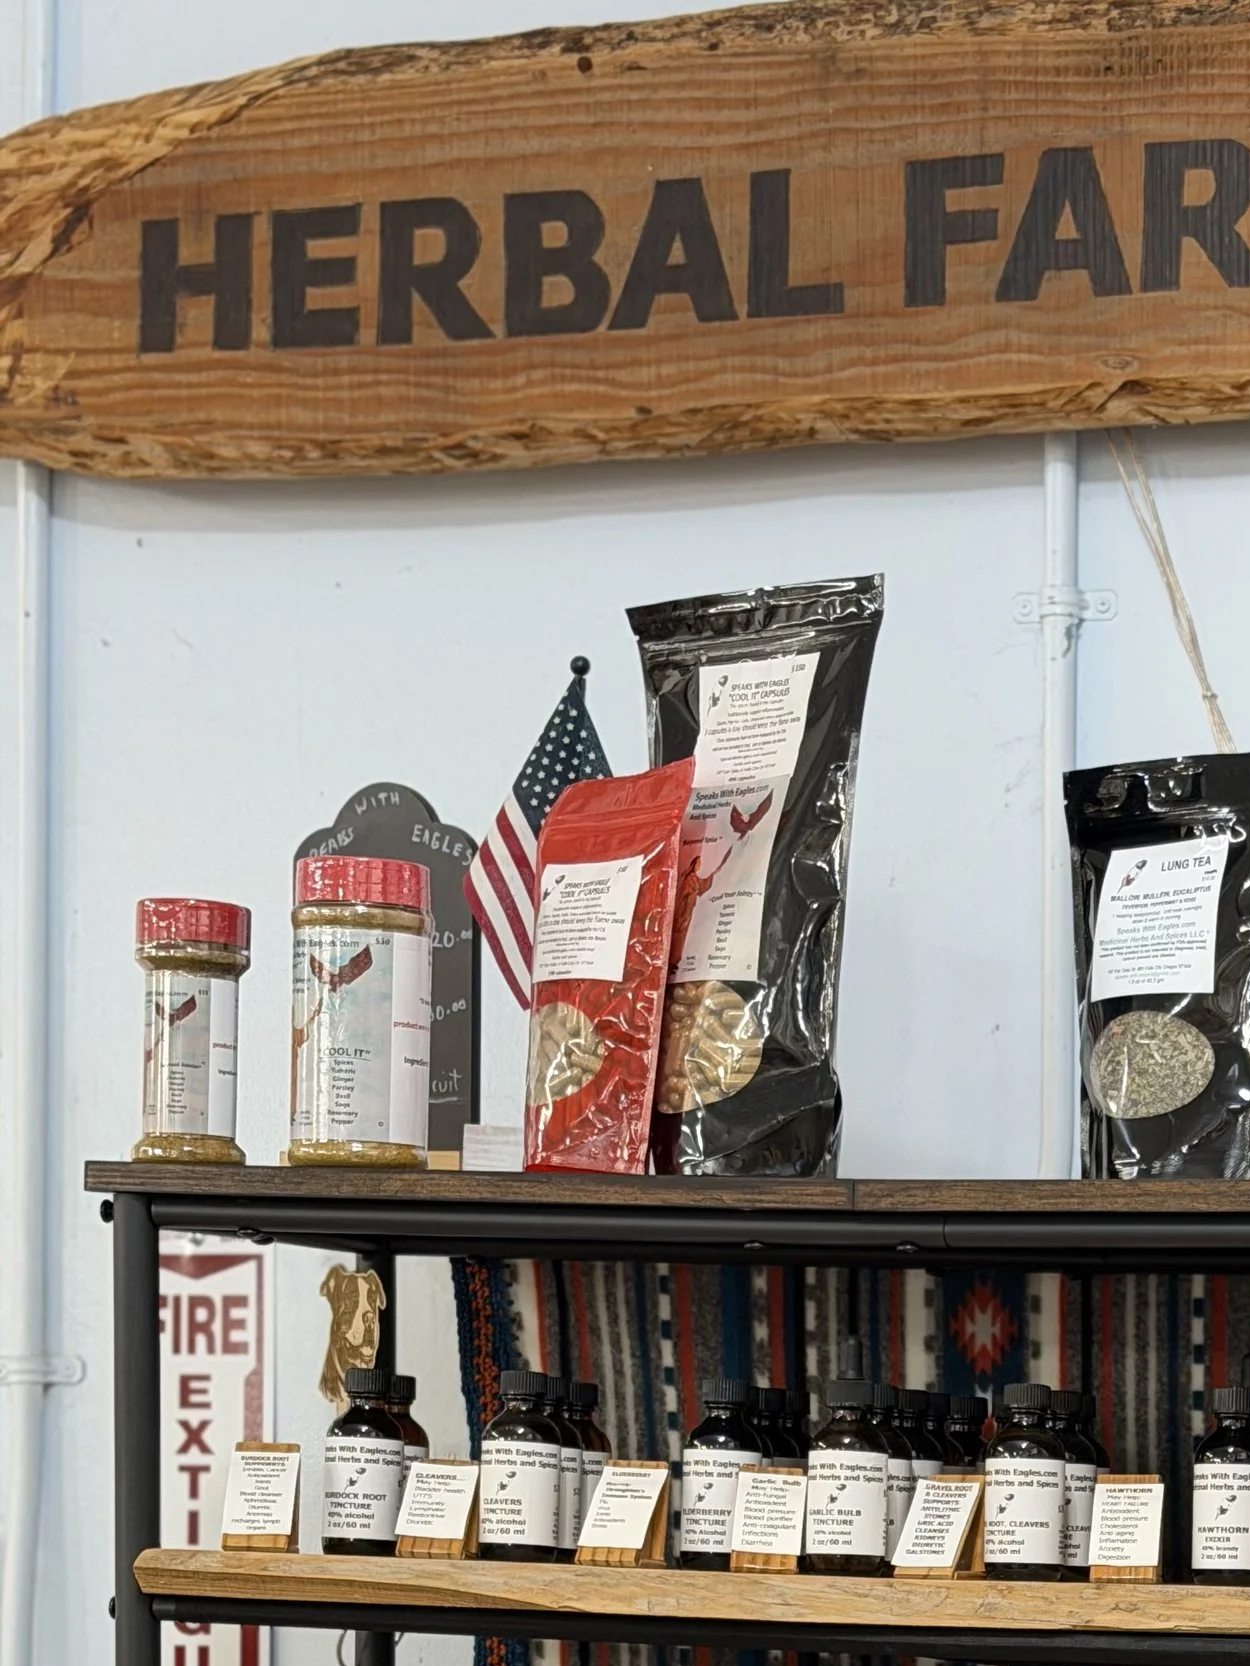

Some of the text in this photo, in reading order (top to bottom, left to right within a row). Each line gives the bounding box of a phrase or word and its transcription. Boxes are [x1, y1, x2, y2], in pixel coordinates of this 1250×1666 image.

[138, 168, 845, 353] HERBAL
[355, 791, 400, 816] WITH
[412, 824, 472, 866] EAGLES
[1161, 856, 1211, 871] LUNG TEA
